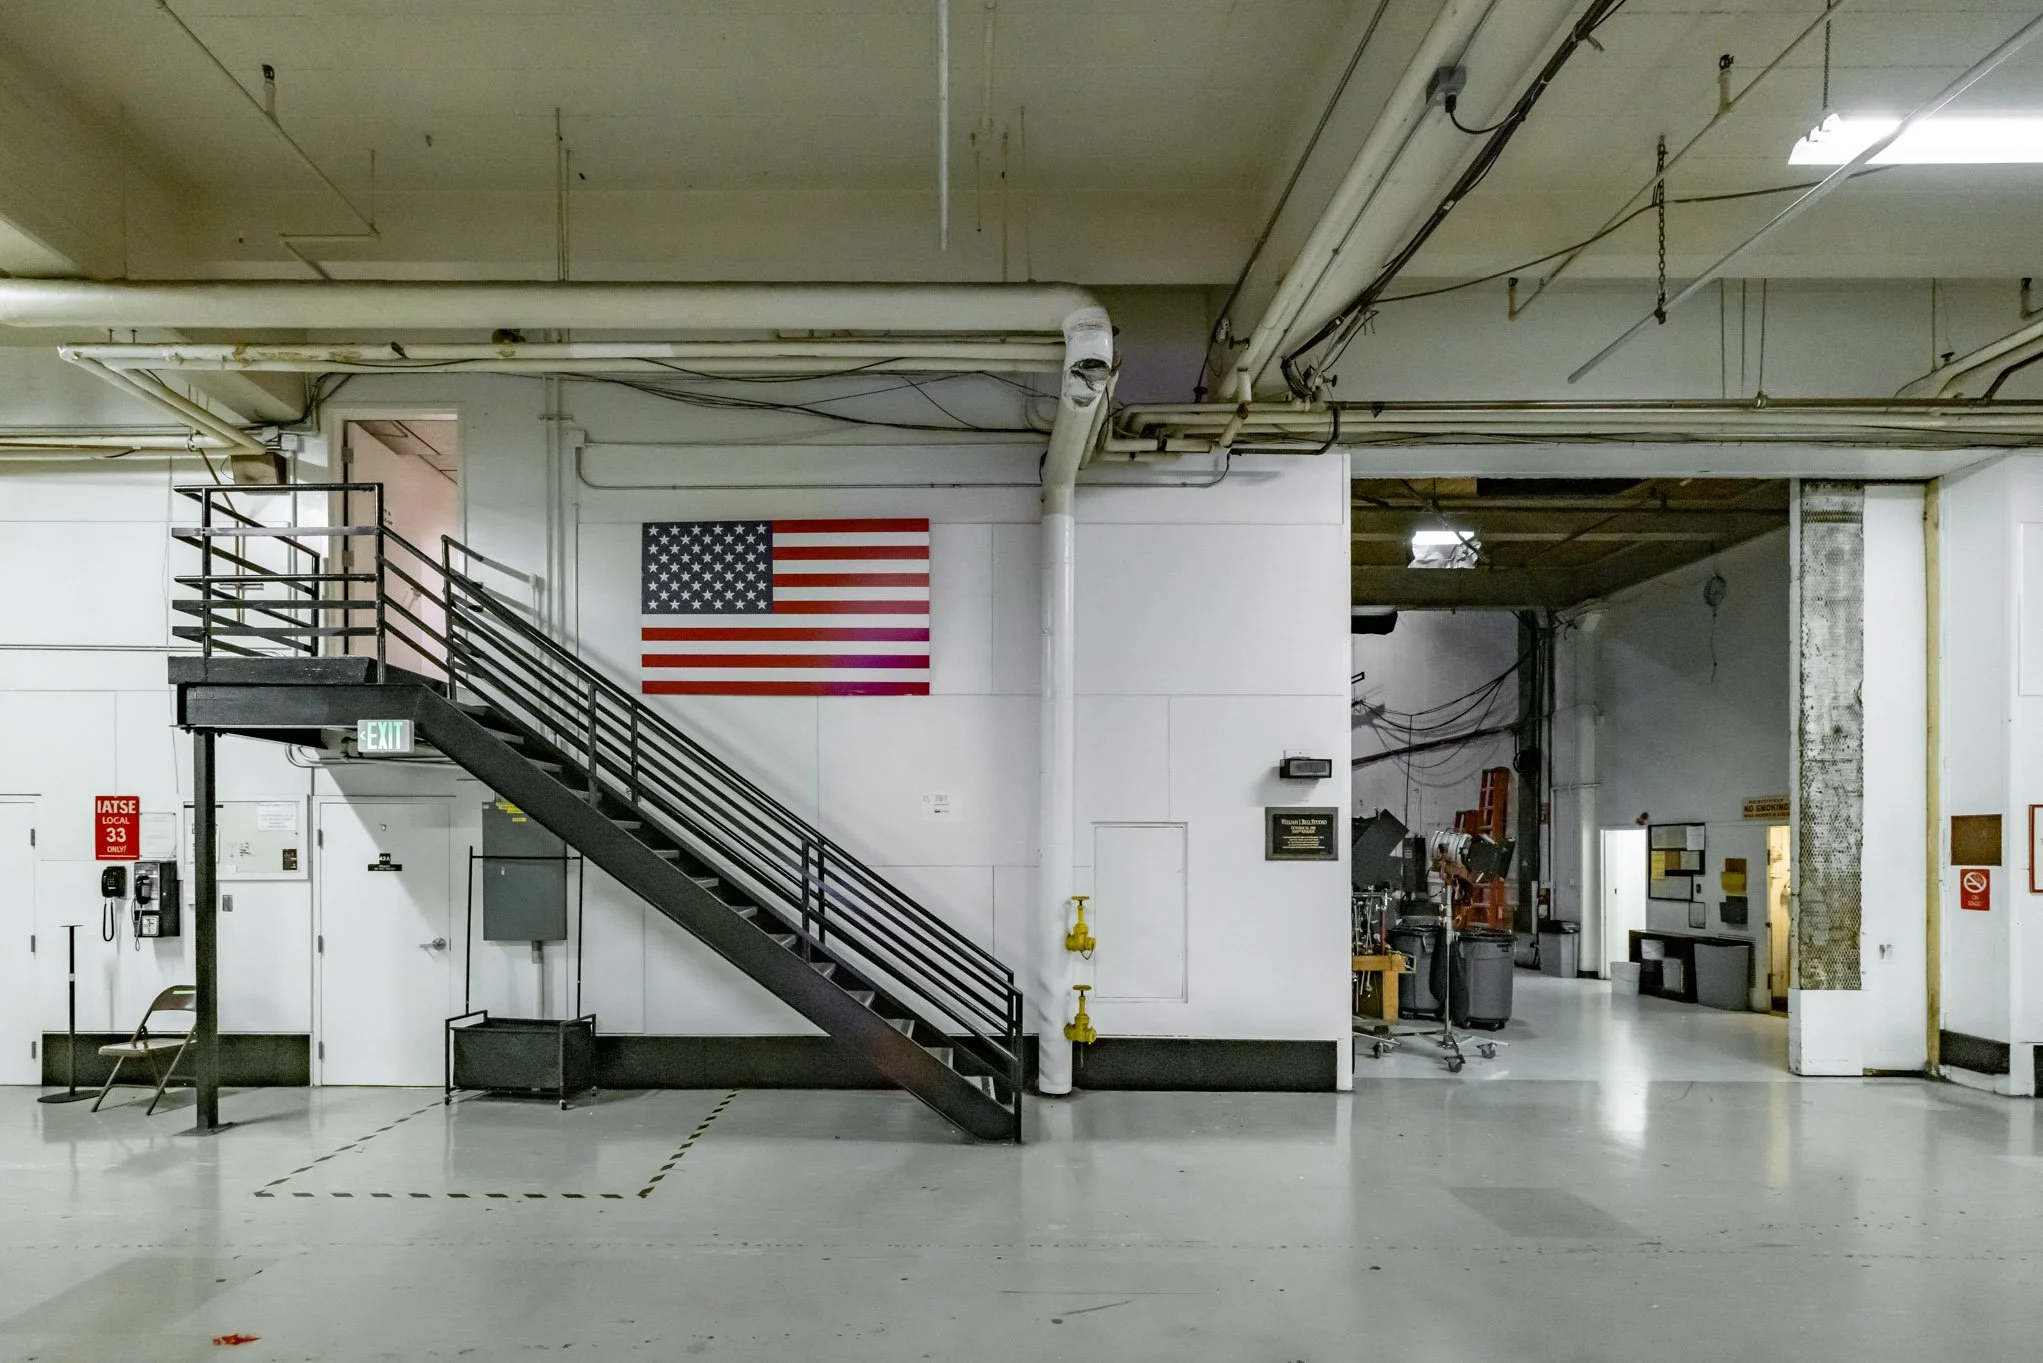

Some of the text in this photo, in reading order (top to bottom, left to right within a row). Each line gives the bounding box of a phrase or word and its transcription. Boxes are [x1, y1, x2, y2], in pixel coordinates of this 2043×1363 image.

[368, 721, 403, 749] EXIT
[97, 800, 136, 814] IATSE
[1755, 803, 1790, 812] SMOKING
[102, 816, 130, 825] LOCAL
[106, 827, 127, 843] 33
[107, 845, 127, 853] ONLY!
